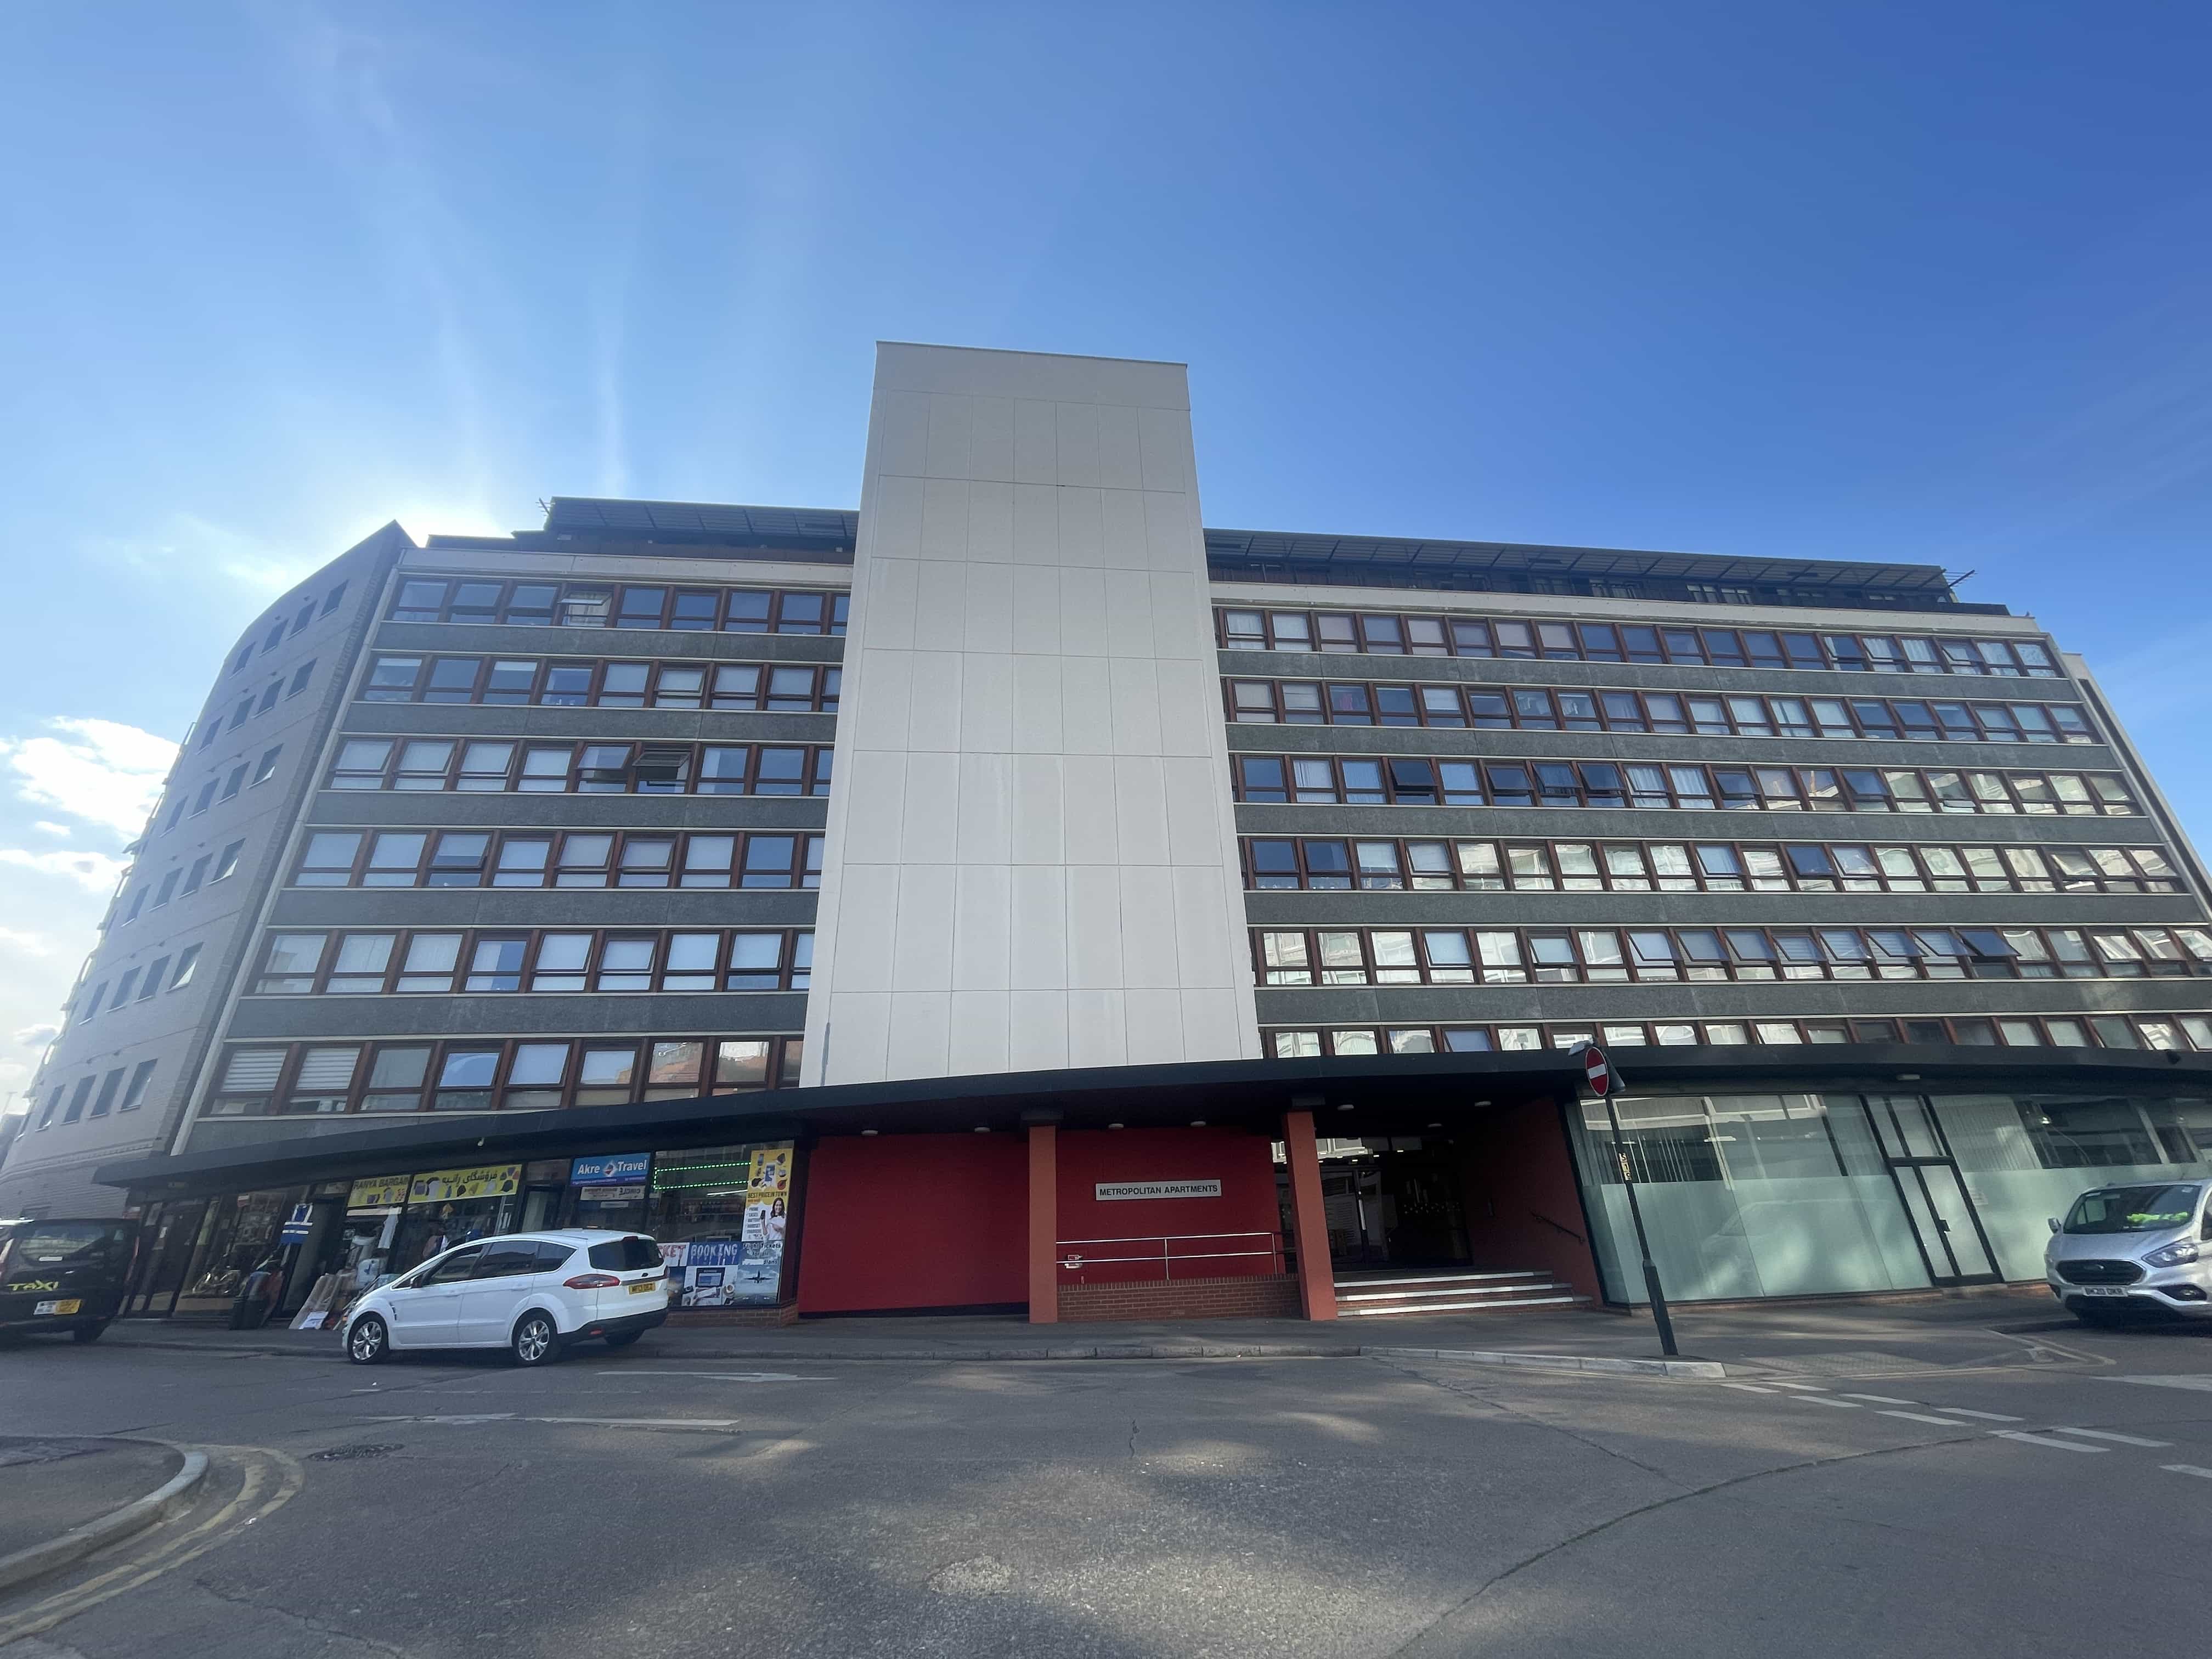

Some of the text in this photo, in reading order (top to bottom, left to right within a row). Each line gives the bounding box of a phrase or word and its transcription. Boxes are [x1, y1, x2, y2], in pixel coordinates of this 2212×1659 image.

[578, 1159, 647, 1175] Akre Travel
[1099, 1184, 1218, 1196] METROPOLITAN APARTMENTS
[691, 1243, 737, 1257] BOOKING
[6, 1280, 59, 1291] TAXI
